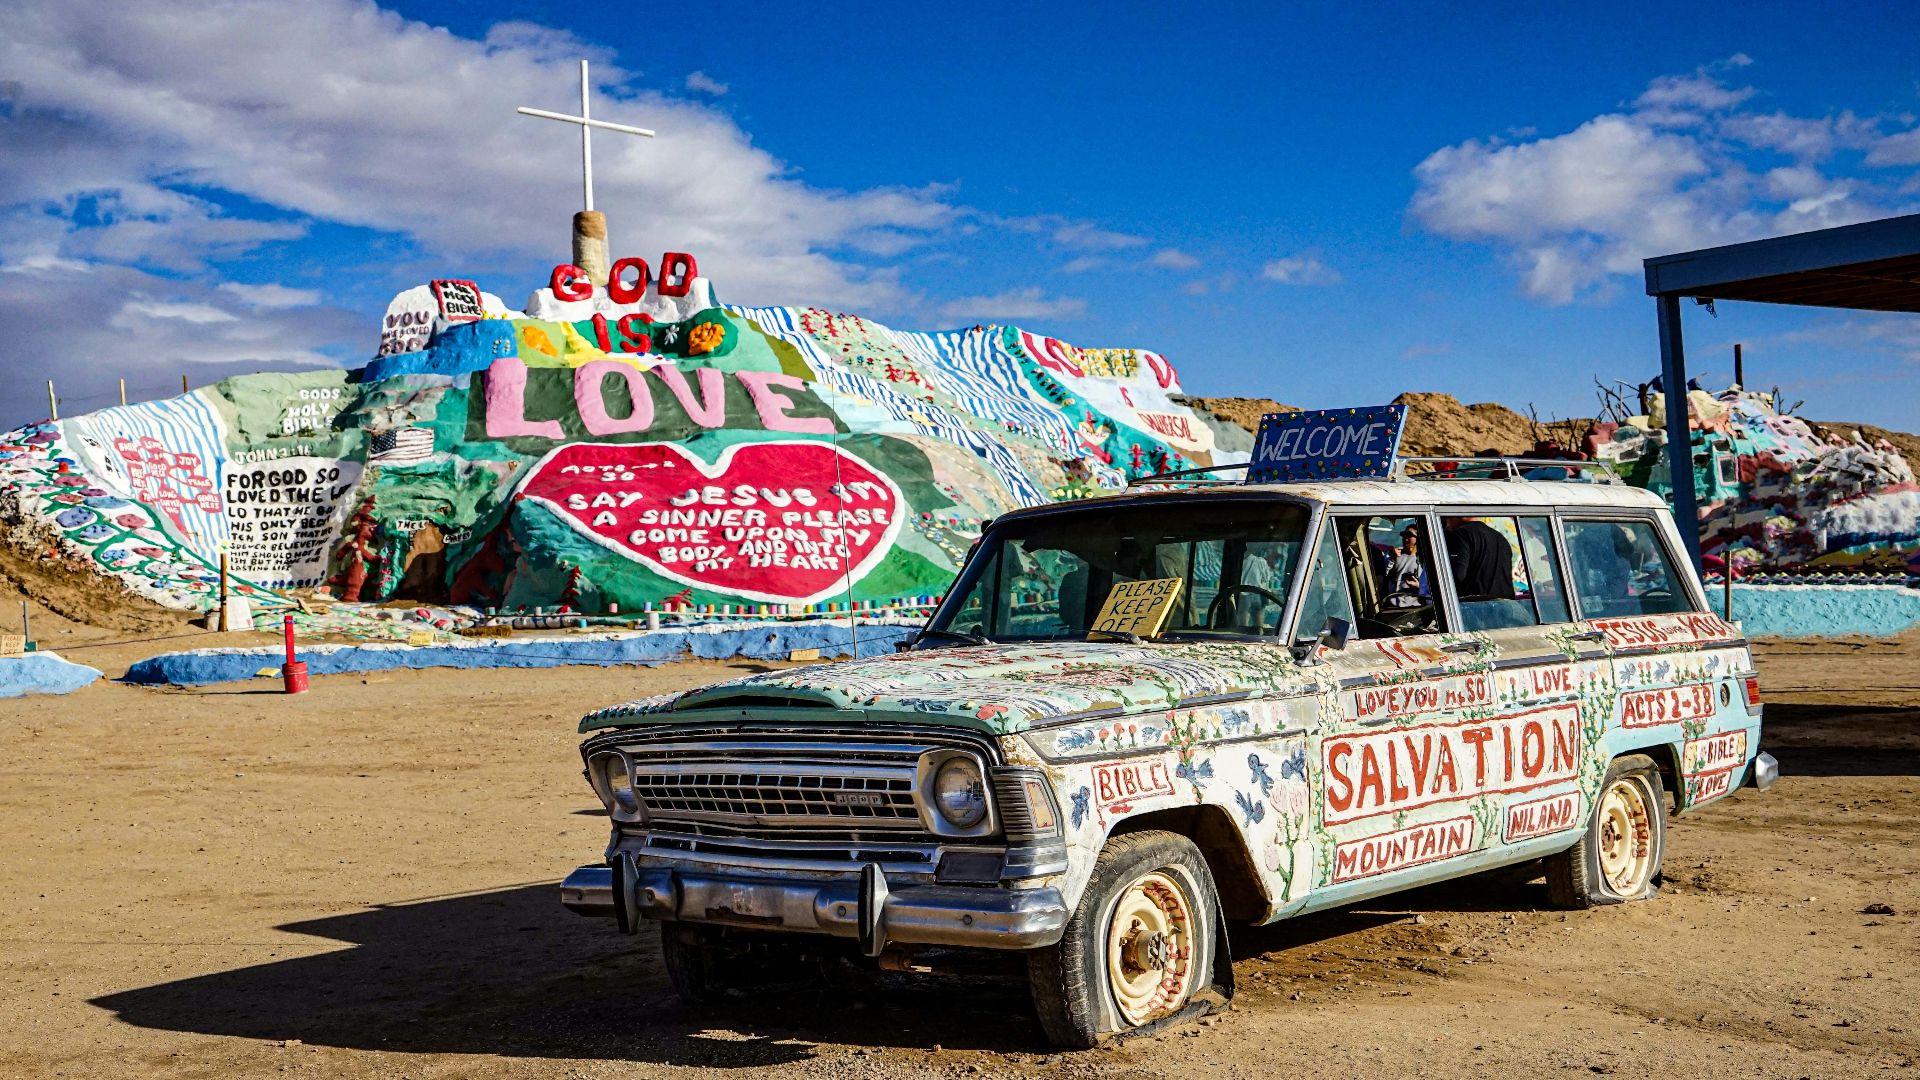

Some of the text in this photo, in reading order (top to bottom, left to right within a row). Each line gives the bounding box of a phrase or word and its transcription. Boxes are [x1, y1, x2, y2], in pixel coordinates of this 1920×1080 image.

[550, 252, 698, 304] GOD
[446, 302, 481, 315] BIBLE
[386, 311, 430, 328] YOU
[592, 312, 655, 353] IS
[299, 388, 340, 400] GODS
[485, 358, 838, 440] LOVE
[288, 402, 330, 418] HOLY
[1258, 422, 1386, 462] WELCOME
[179, 456, 198, 466] JOY
[235, 448, 277, 464] JOHN
[227, 467, 339, 489] FOR GOD SO
[226, 489, 280, 503] LOVED
[285, 487, 324, 503] THE
[568, 491, 643, 510] SAY
[670, 484, 817, 507] JESUS
[228, 507, 247, 518] LD
[253, 507, 290, 518] THAT
[292, 506, 311, 515] HE
[592, 508, 890, 527] A SINNER PLEASE
[231, 521, 253, 532] HIS
[260, 518, 296, 530] ONLY
[398, 520, 416, 529] THE
[262, 532, 288, 541] SON
[295, 530, 319, 539] THAT
[629, 526, 871, 547] COME UPON MY
[251, 551, 292, 560] SHOULD
[294, 549, 312, 558] NOT
[658, 539, 852, 564] BODY AND INTO
[695, 553, 839, 572] MY HEART
[1113, 579, 1178, 598] PLEASE
[1109, 596, 1164, 616] KEEP
[1099, 616, 1147, 632] OFF
[1596, 619, 1668, 645] JESUS
[1356, 687, 1400, 717] LOVE
[1402, 686, 1438, 709] YOU
[1622, 684, 1713, 724] ACTS 2-38
[1707, 736, 1735, 764] BIBLE
[1328, 718, 1576, 812] SALVATION
[1098, 762, 1168, 801] BIBLE
[1697, 773, 1727, 798] LOVE
[1336, 821, 1466, 877] MOUNTAIN
